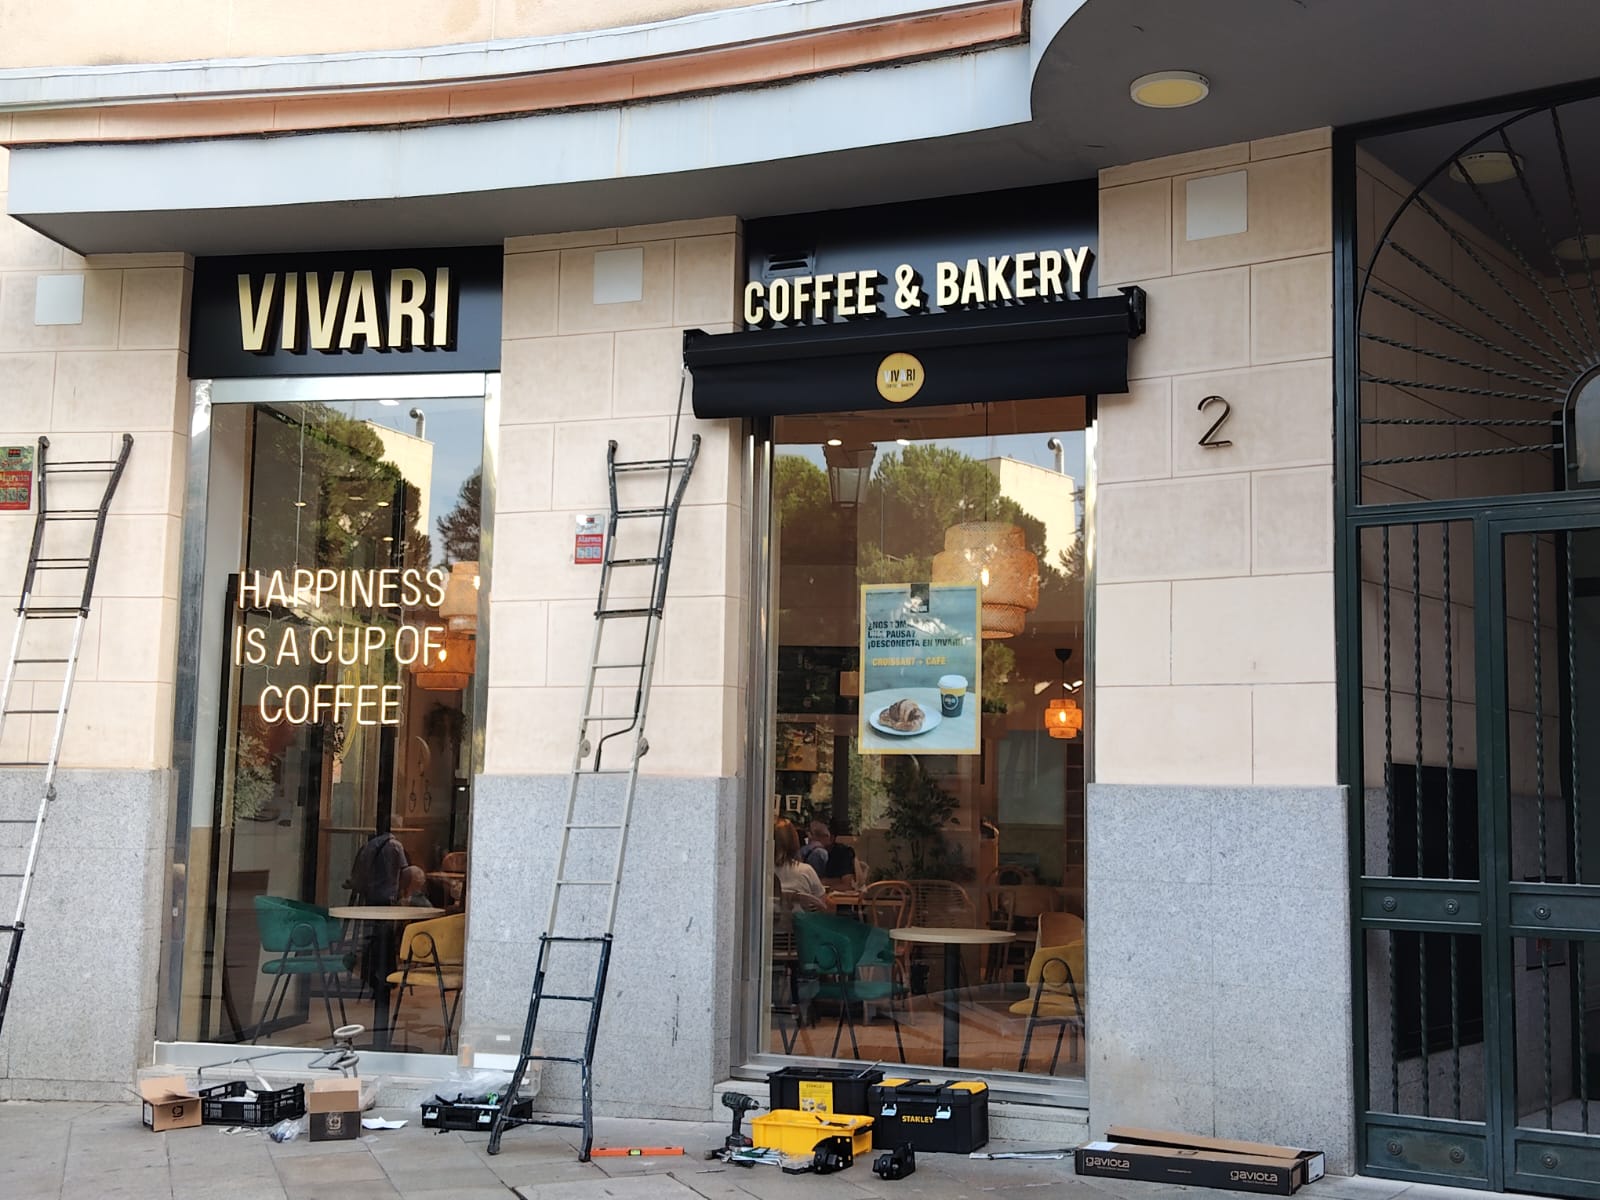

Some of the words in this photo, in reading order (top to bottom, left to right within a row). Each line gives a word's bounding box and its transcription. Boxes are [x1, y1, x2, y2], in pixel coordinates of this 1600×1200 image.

[744, 270, 878, 324] COFFEE
[894, 264, 921, 310] &
[936, 246, 1089, 307] BAKERY
[237, 266, 450, 351] VIVARI
[1197, 395, 1233, 448] 2
[238, 568, 445, 608] HAPPINESS
[235, 626, 266, 666] IS
[276, 627, 299, 666] A
[310, 626, 386, 666] CUP
[259, 685, 403, 725] COFFEE
[902, 1115, 934, 1124] STANLEY
[1085, 1156, 1130, 1169] gaviota
[1230, 1170, 1278, 1183] gaviota
